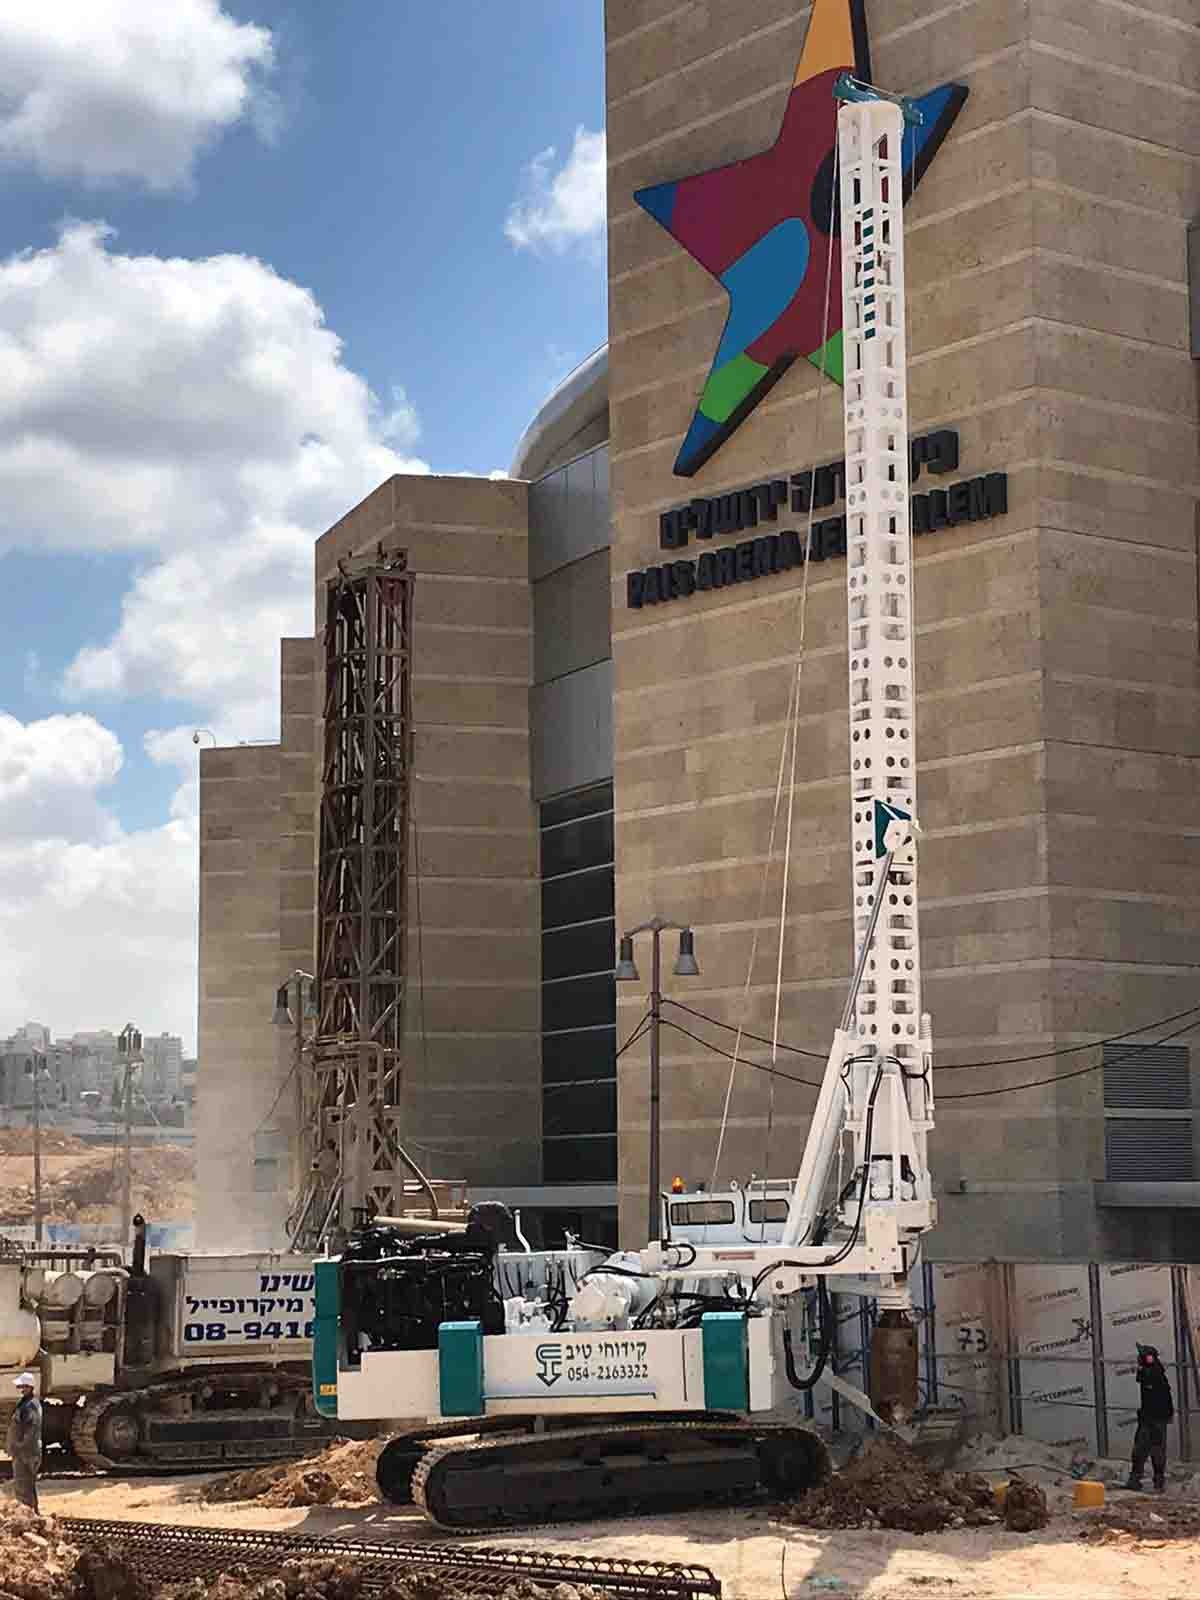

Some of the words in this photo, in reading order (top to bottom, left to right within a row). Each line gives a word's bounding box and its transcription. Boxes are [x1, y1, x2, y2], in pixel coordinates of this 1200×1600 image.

[692, 530, 803, 591] ARENA
[186, 1296, 304, 1317] מיקרופייל
[566, 1344, 593, 1361] טיב
[598, 1341, 647, 1361] קידוחי
[567, 1363, 649, 1382] 054-2163322
